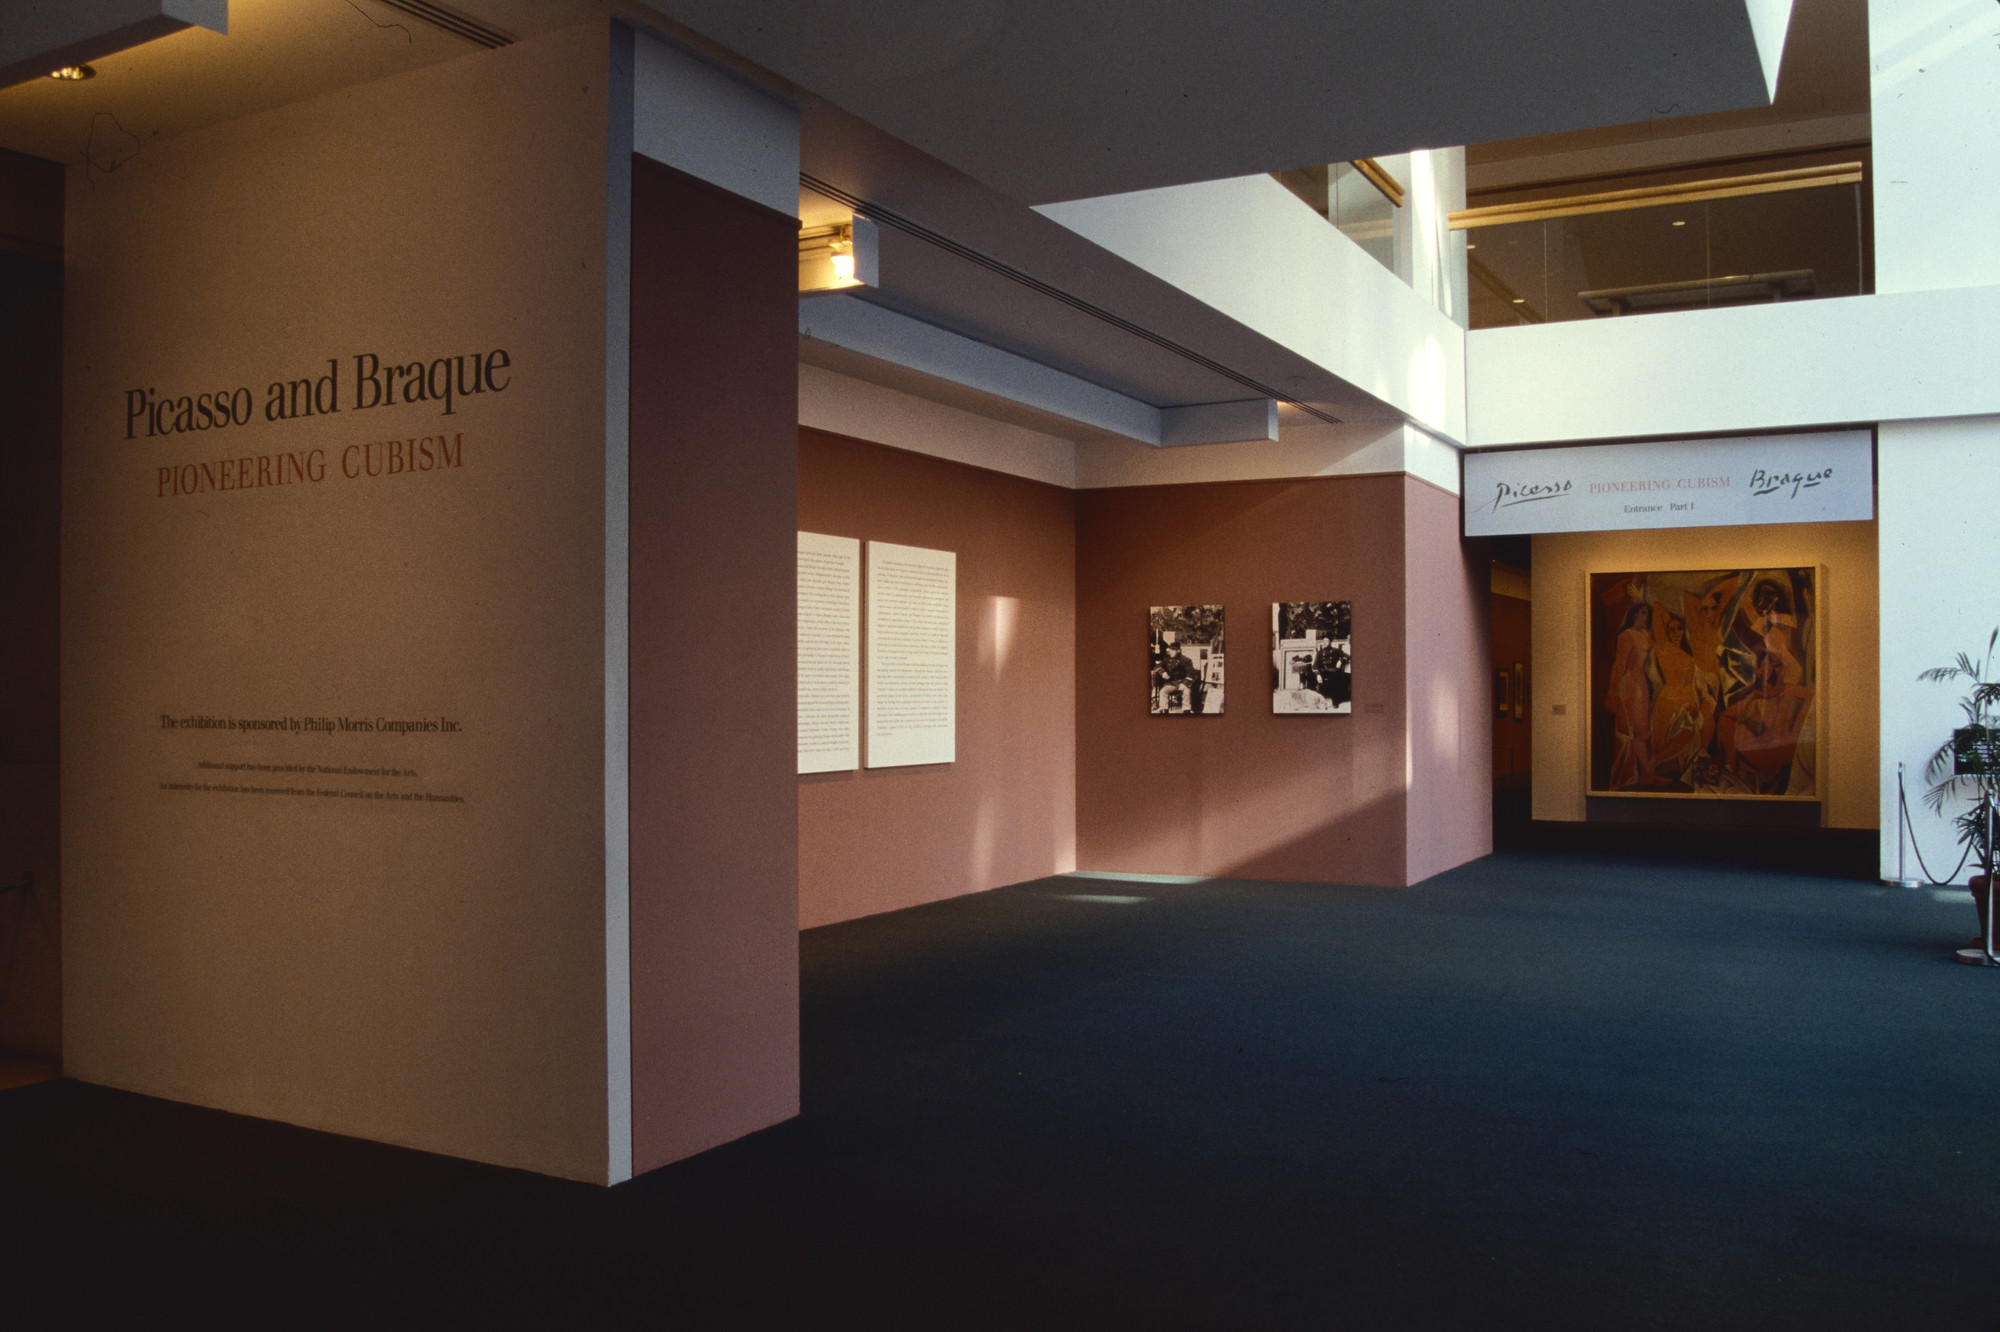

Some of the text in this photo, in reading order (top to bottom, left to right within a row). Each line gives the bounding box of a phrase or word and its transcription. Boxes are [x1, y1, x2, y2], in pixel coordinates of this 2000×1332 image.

[124, 349, 511, 440] Picasso and Braque
[157, 433, 464, 497] PIONEERING CUBISM
[1589, 476, 1731, 494] PIONEERING CUBISM
[1749, 468, 1834, 499] Braque
[1624, 504, 1663, 513] Entrance
[1669, 502, 1688, 511] Part
[160, 714, 463, 735] The exhibition is sponsored by Philip Morris Companies Inc.
